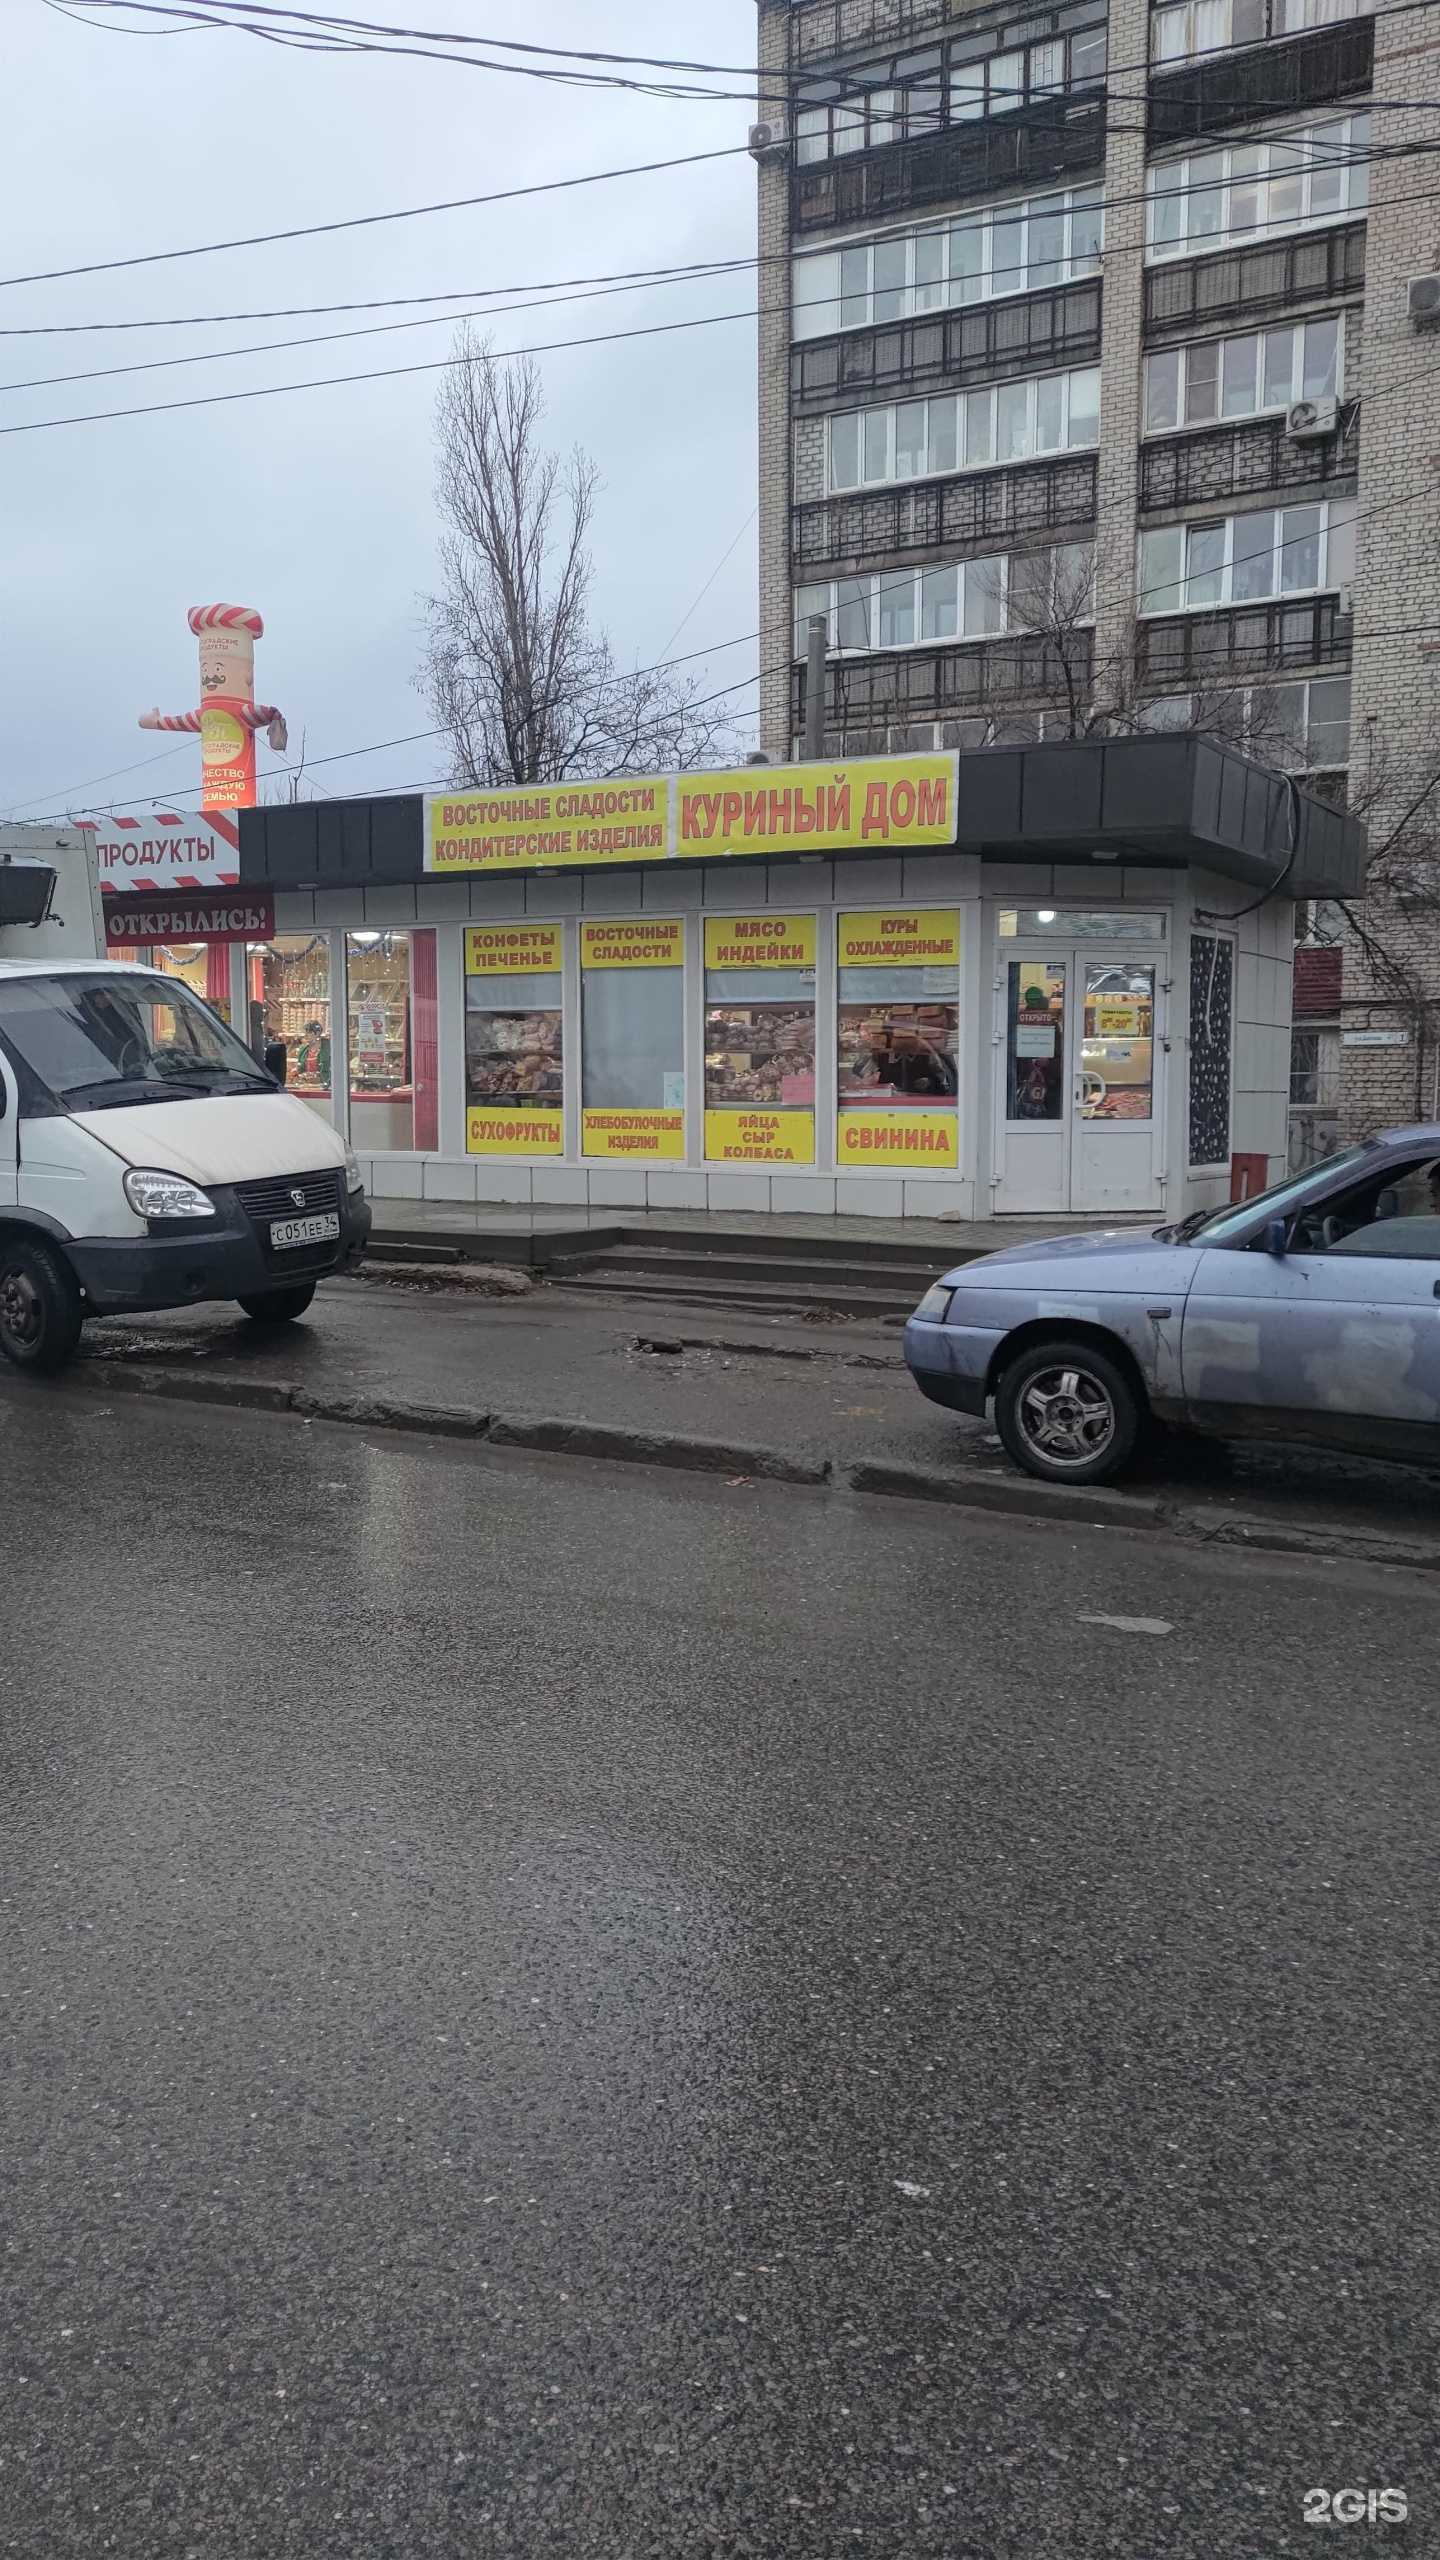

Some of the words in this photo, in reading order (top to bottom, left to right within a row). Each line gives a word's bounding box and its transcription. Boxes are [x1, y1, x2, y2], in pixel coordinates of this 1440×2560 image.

[443, 799, 551, 827] ВОСТОЧНЫЕ
[556, 788, 655, 820] СЛАДОСТИ
[682, 774, 852, 839] КУРИНЫЙ
[862, 778, 948, 838] ДОМ
[96, 836, 215, 867] ПРОДУКТЫ
[436, 831, 572, 862] КОНДИТЕРСКИЕ
[577, 824, 662, 851] ИЗДЕЛИЯ
[109, 906, 267, 936] ОТКРЫЛИСЬ!
[735, 922, 786, 937] МЯСО
[880, 919, 918, 935] КУРЫ
[472, 932, 555, 949] КОНФЕТЫ
[586, 925, 678, 942] ВОСТОЧНЫЕ
[592, 944, 672, 961] СЛАДОСТИ
[717, 942, 804, 963] ИНДЕЙКИ
[846, 938, 953, 958] ОХЛАЖДЕННЫЕ
[476, 951, 553, 967] ПЕЧЕНЬЕ
[585, 1115, 682, 1131] ХЛЕБОБУЛОЧНЫЕ
[738, 1114, 780, 1130] ЯЙЦА
[471, 1121, 561, 1143] СУХОФРУКТЫ
[742, 1132, 775, 1144] СЫР
[845, 1127, 950, 1151] СВИНИНА
[608, 1135, 659, 1151] ИЗДЕЛИЯ
[723, 1146, 794, 1160] КОЛБАСА
